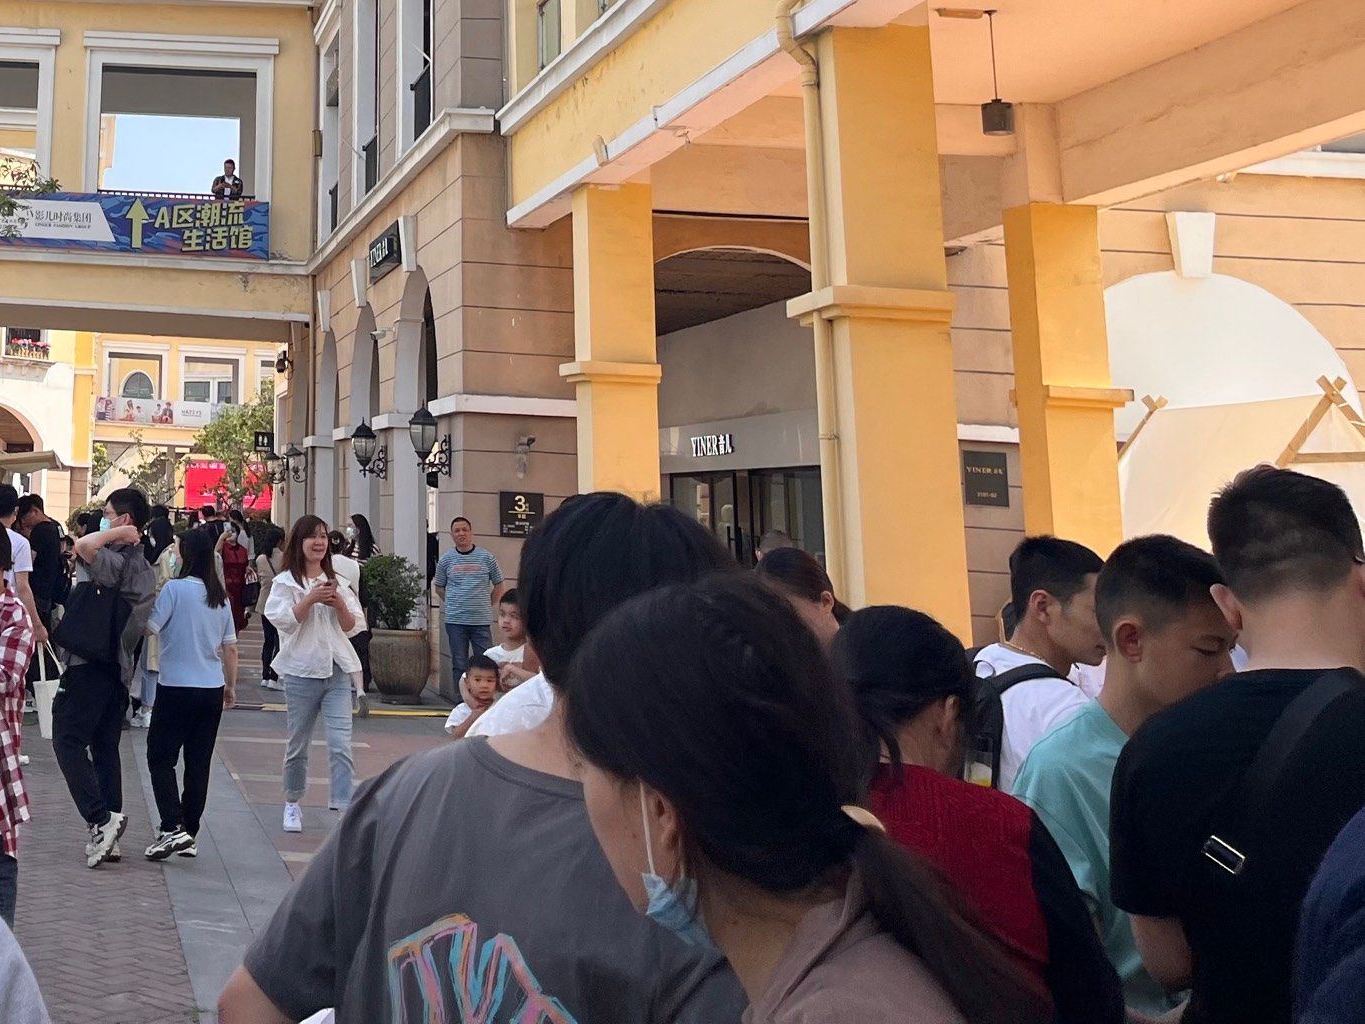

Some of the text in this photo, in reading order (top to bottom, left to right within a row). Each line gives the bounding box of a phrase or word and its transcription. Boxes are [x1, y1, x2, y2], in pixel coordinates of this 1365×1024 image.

[154, 201, 245, 229] A区潮流
[181, 226, 253, 252] 生活馆
